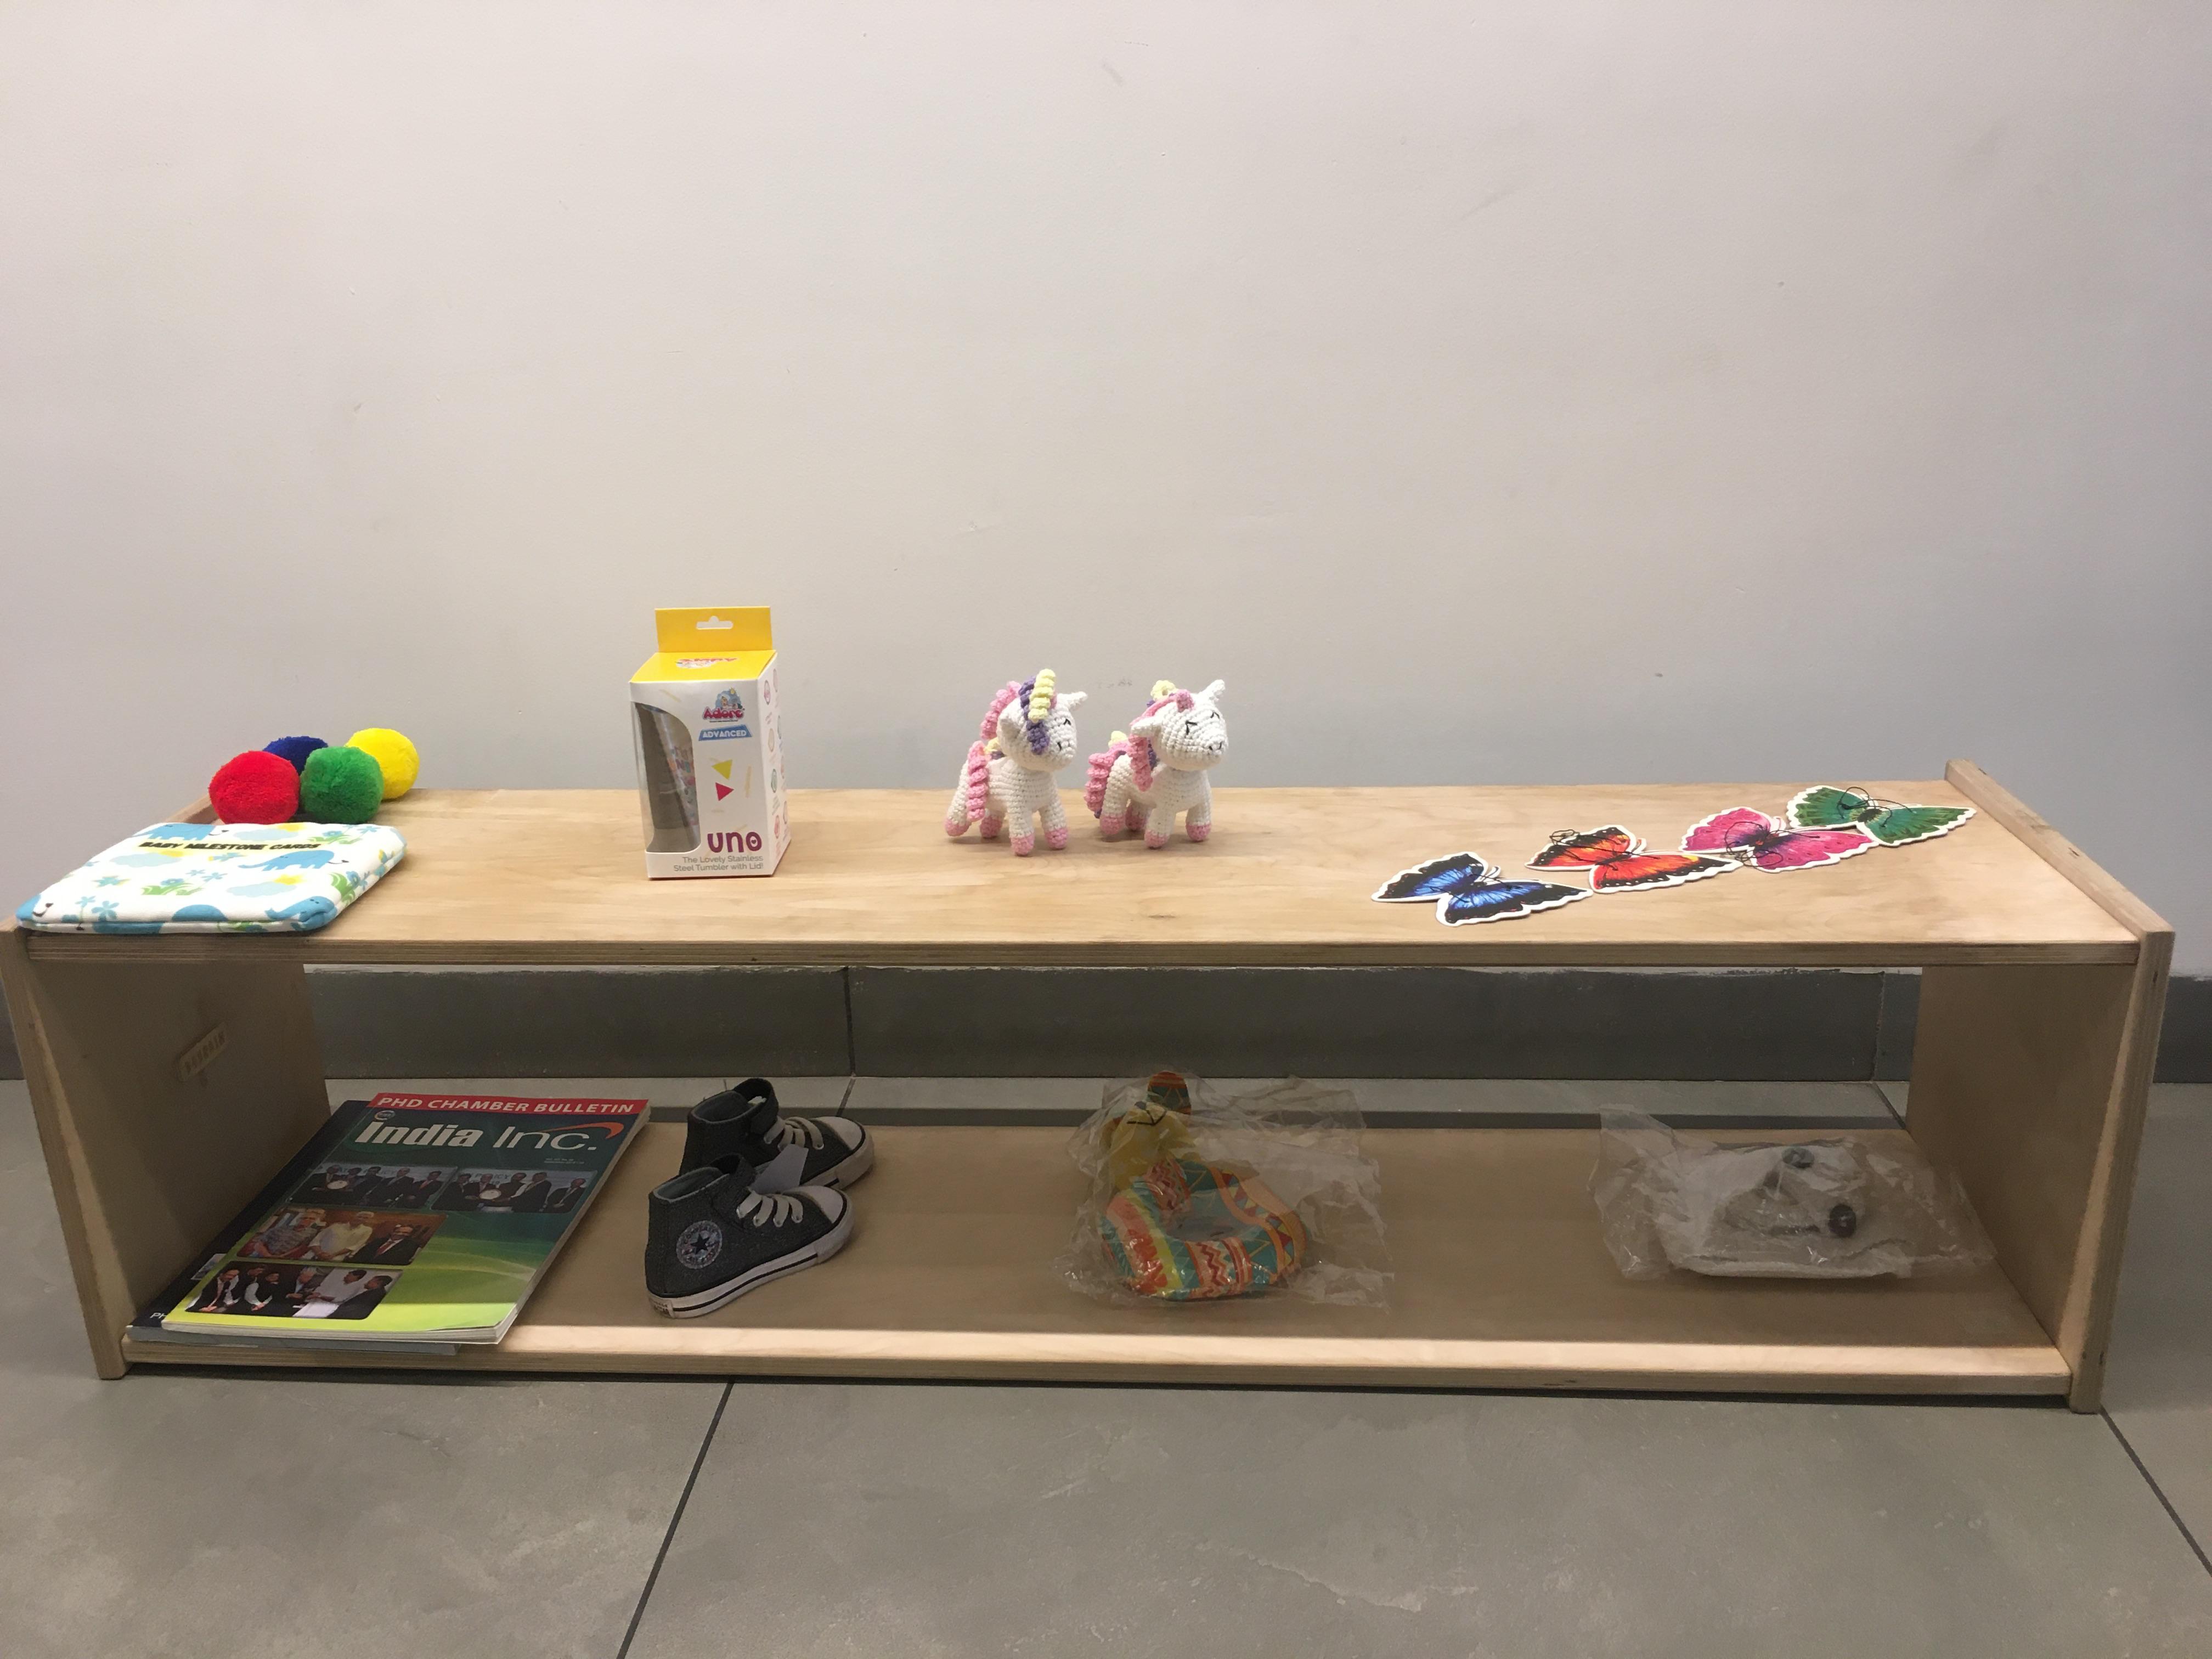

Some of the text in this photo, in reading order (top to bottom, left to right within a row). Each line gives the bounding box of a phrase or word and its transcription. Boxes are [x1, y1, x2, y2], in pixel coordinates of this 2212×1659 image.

[703, 707, 744, 719] Adore
[702, 730, 747, 738] ADVANCED
[699, 855, 726, 864] Lovely
[727, 854, 764, 862] Stainless
[377, 1097, 634, 1113] PHD CHAMBER BULLETIN
[354, 1121, 597, 1150] India Inc.
